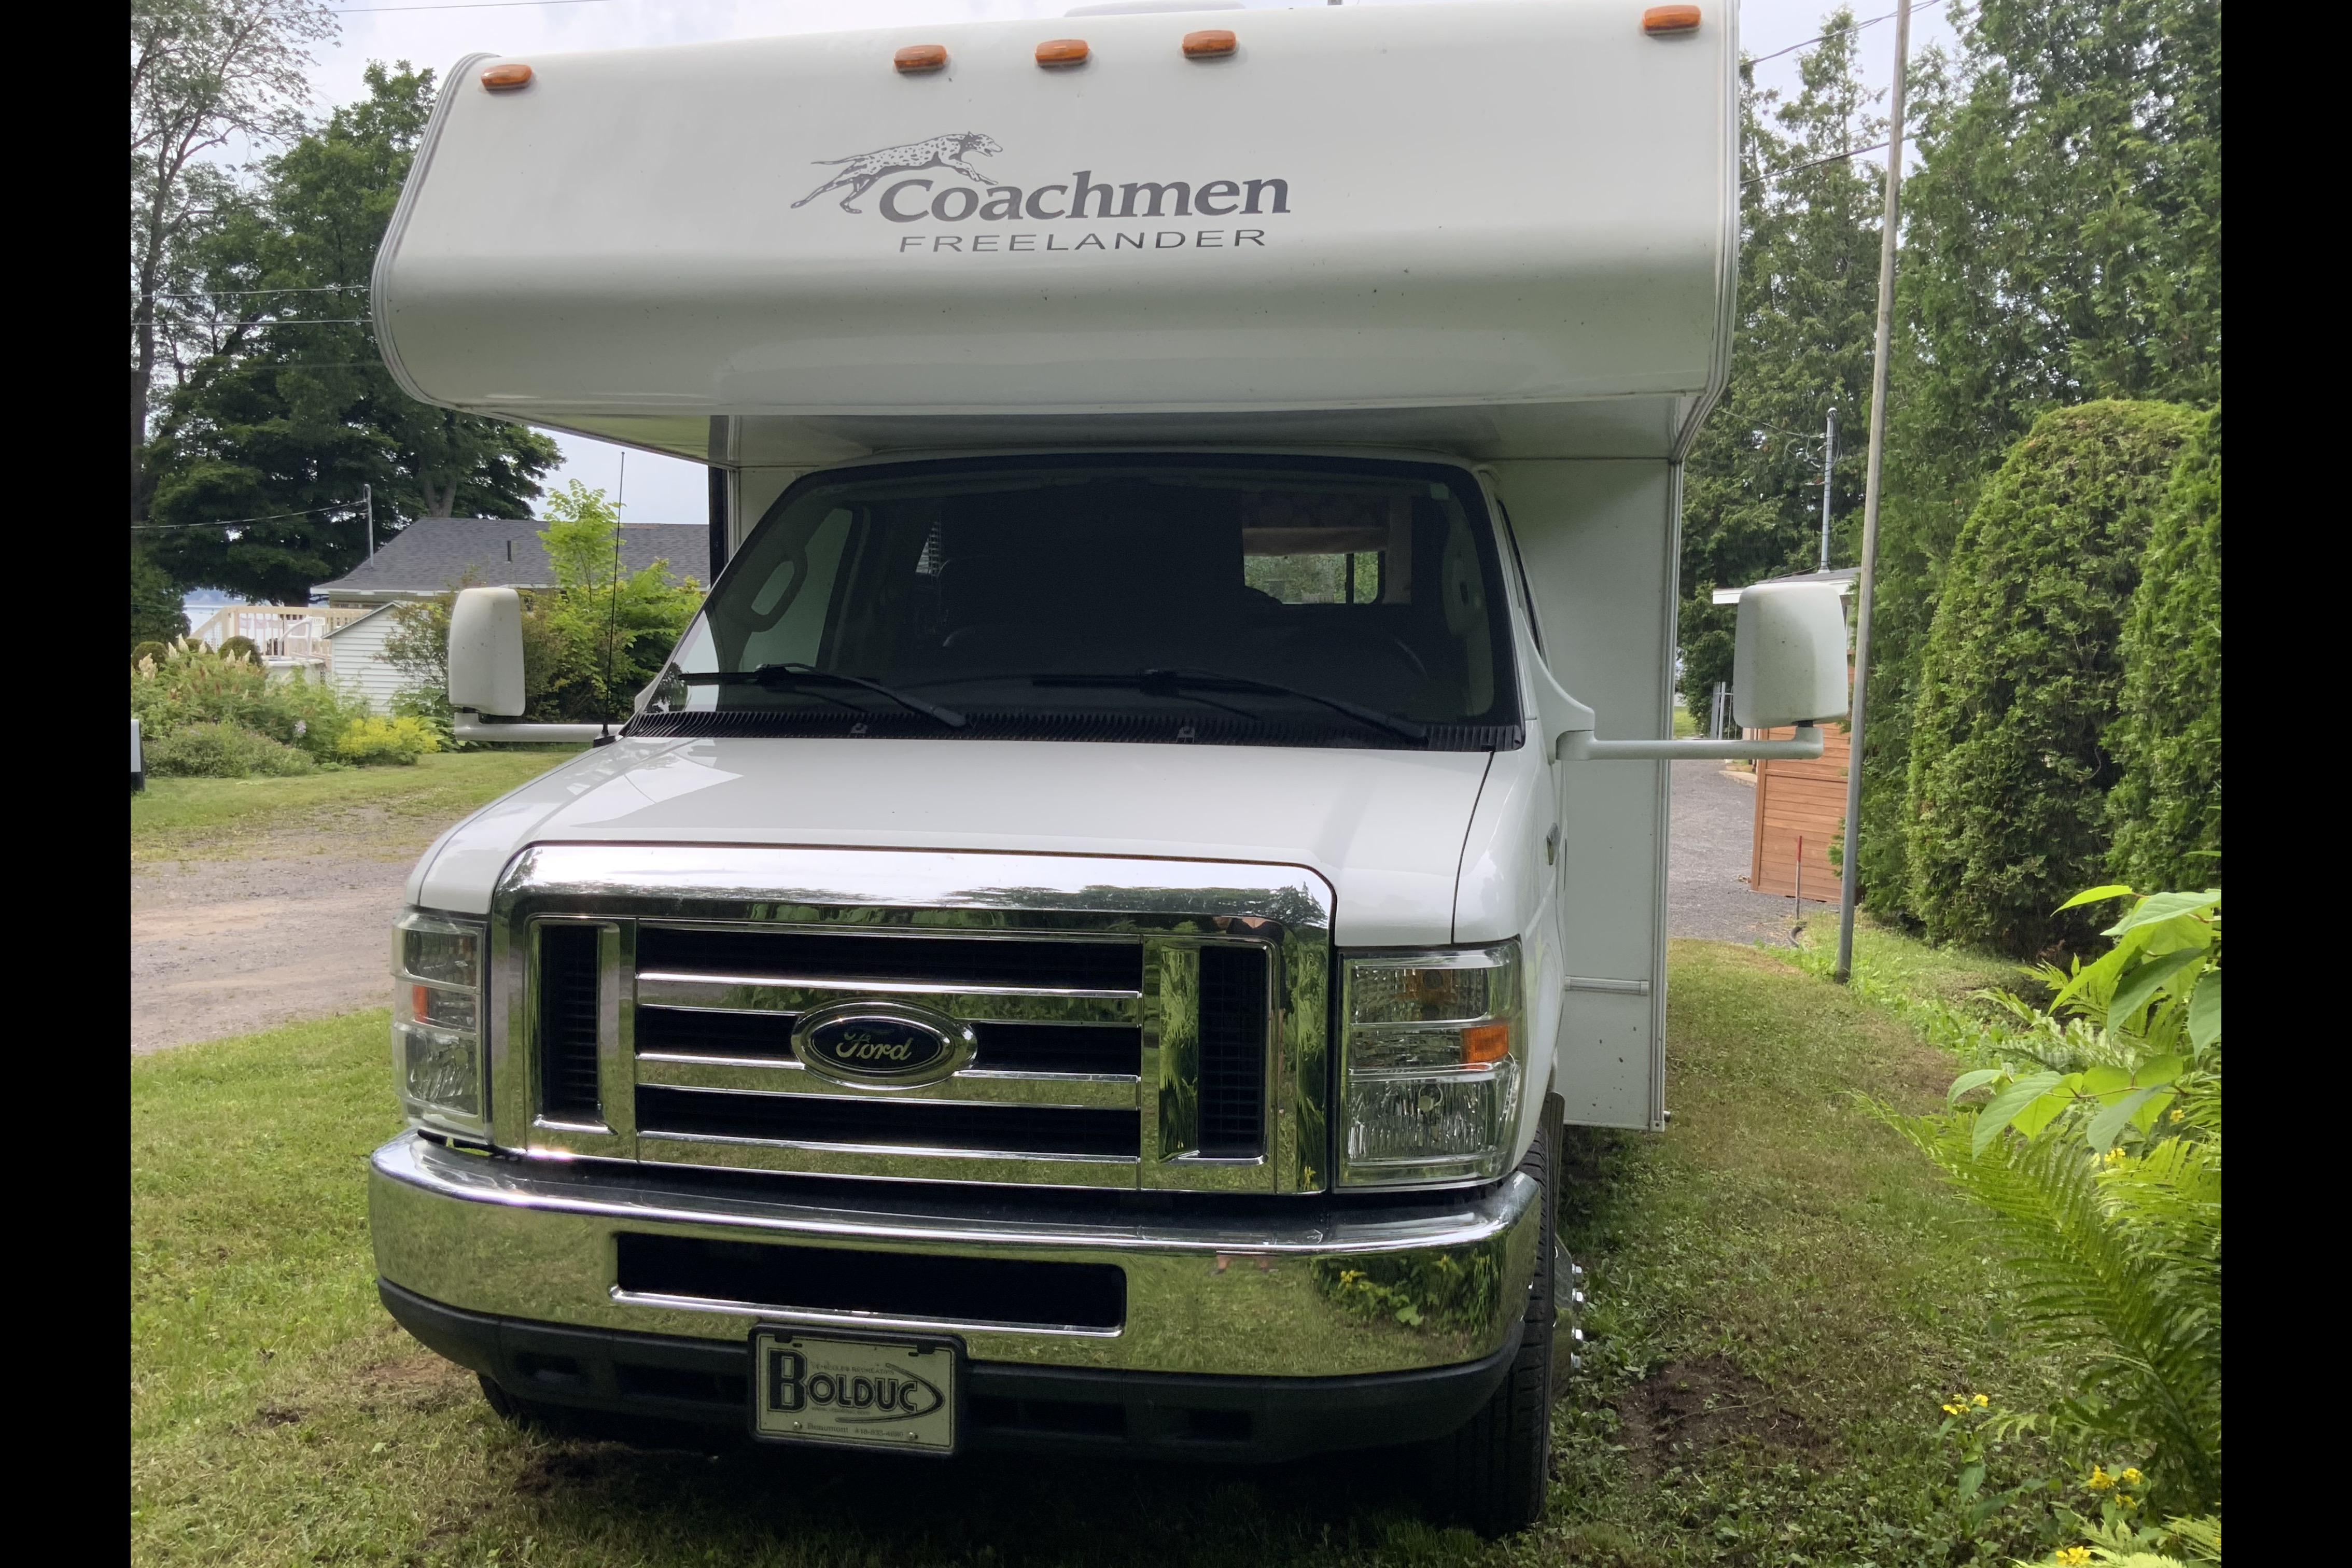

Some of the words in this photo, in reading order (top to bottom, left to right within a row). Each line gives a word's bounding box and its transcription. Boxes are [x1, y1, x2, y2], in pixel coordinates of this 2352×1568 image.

[879, 170, 1291, 222] Coachmen
[899, 229, 1266, 253] FREELANDER
[835, 1031, 913, 1060] Ford
[767, 1347, 918, 1413] BOLDUC
[807, 1423, 848, 1433] Beaumont
